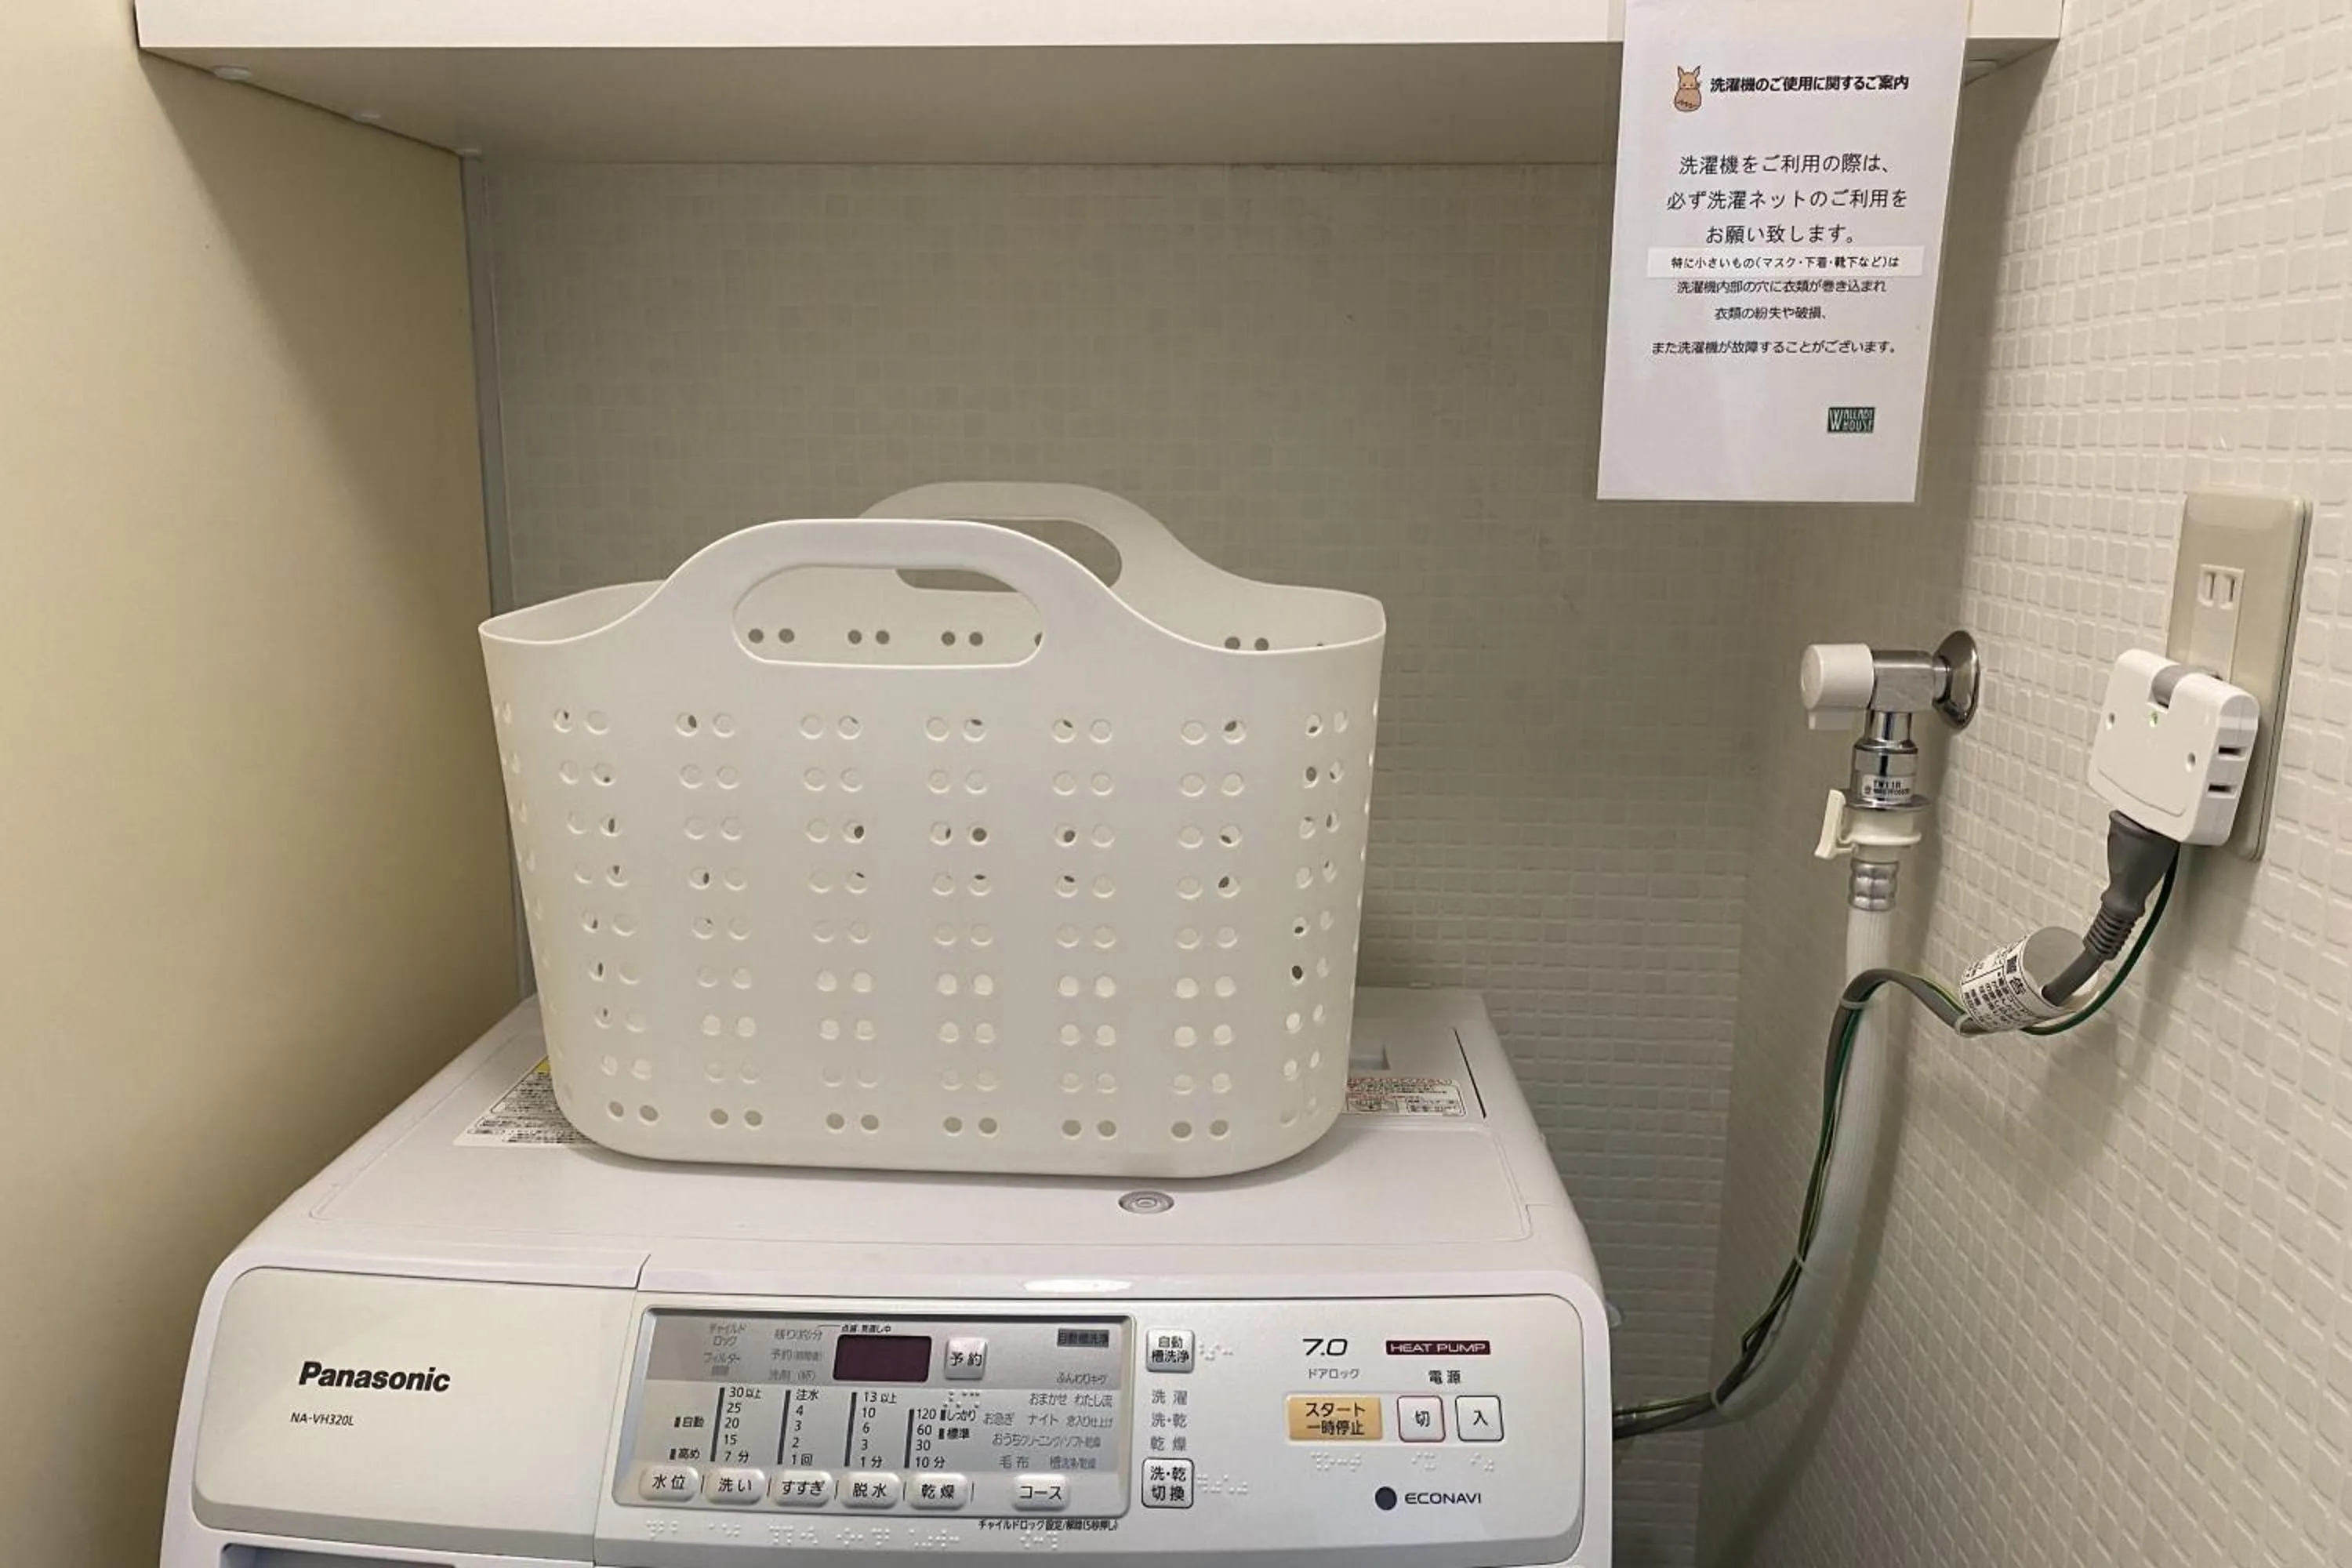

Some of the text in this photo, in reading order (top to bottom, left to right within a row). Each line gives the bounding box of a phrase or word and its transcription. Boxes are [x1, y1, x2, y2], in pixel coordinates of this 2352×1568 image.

[1710, 74, 1909, 93] 洗濯機のご使用に関するご案内
[1679, 153, 1889, 176] 洗濯機をご利用の際は、
[1666, 188, 1907, 210] 必ず洗濯ネットのご利用を
[1705, 224, 1856, 244] お願い致します。
[1677, 279, 1888, 294] 洗濯機内部の穴に衣類が巻き込まれ
[1715, 306, 1827, 321] 衣類の紛失や破損、
[1651, 340, 1896, 354] また洗濯機が故障することがございます。
[1158, 1335, 1183, 1348] 自動
[1302, 1338, 1348, 1356] 7.0
[1390, 1343, 1486, 1353] HEAT PUMP
[949, 1351, 982, 1367] 予約
[1152, 1349, 1189, 1363] 槽洗浄
[299, 1361, 452, 1392] Panasonic
[1308, 1368, 1360, 1380] ドアロック
[1428, 1370, 1461, 1385] 電源
[796, 1388, 819, 1401] 注水
[1029, 1392, 1068, 1406] おまかせ
[1152, 1388, 1189, 1406] 洗濯
[726, 1403, 742, 1414] 25
[796, 1405, 804, 1416] 4
[862, 1407, 877, 1418] 10
[917, 1408, 937, 1420] 120
[1305, 1402, 1366, 1417] スタート
[724, 1417, 740, 1429] 20
[795, 1420, 802, 1432] 3
[1028, 1413, 1059, 1426] ナイト
[1414, 1410, 1431, 1427] 切
[1472, 1410, 1489, 1427] 入
[862, 1422, 870, 1434] 6
[916, 1425, 932, 1436] 60
[1306, 1420, 1365, 1436] 一時停止
[724, 1434, 737, 1445] 15
[792, 1437, 800, 1448] 2
[862, 1439, 869, 1451] 3
[916, 1439, 931, 1451] 30
[1150, 1436, 1186, 1452] 乾燥
[652, 1475, 686, 1490] 水位
[718, 1477, 751, 1493] 洗い
[782, 1480, 826, 1497] すすぎ
[852, 1483, 887, 1498] 脱水
[921, 1483, 955, 1500] 乾燥
[1019, 1484, 1062, 1501] コース
[1151, 1485, 1185, 1501] 切換
[1404, 1492, 1483, 1504] ECONAVI
